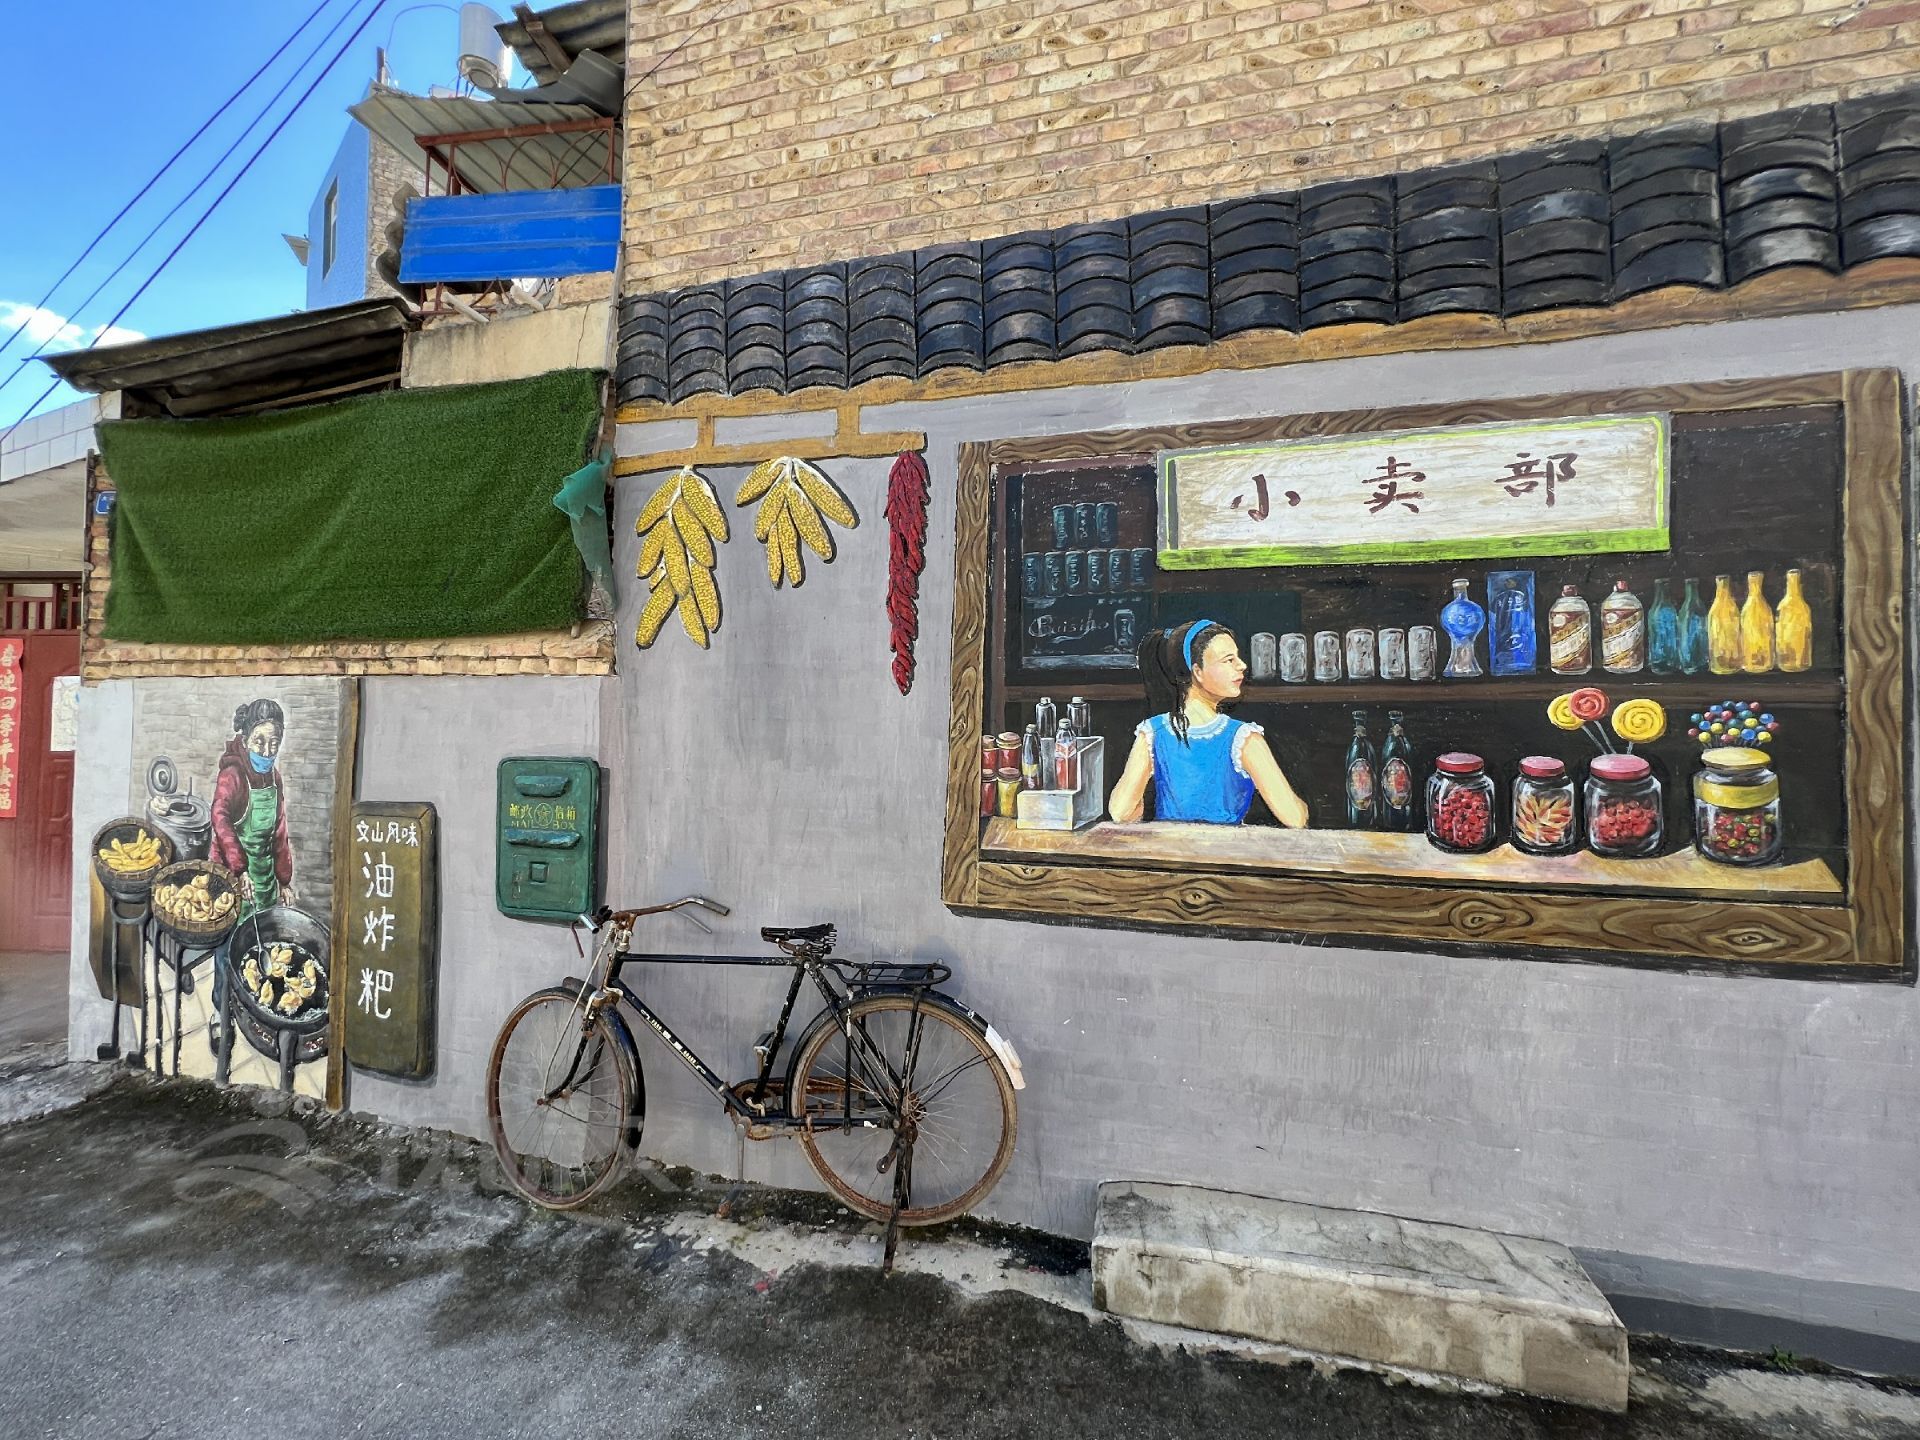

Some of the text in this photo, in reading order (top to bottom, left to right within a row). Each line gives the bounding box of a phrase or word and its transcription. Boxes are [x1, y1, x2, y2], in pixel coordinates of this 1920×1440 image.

[1230, 452, 1579, 523] 小卖部
[356, 820, 419, 847] 文山风味
[511, 819, 577, 831] MAIL BOX
[357, 851, 395, 1019] 油炸粑
